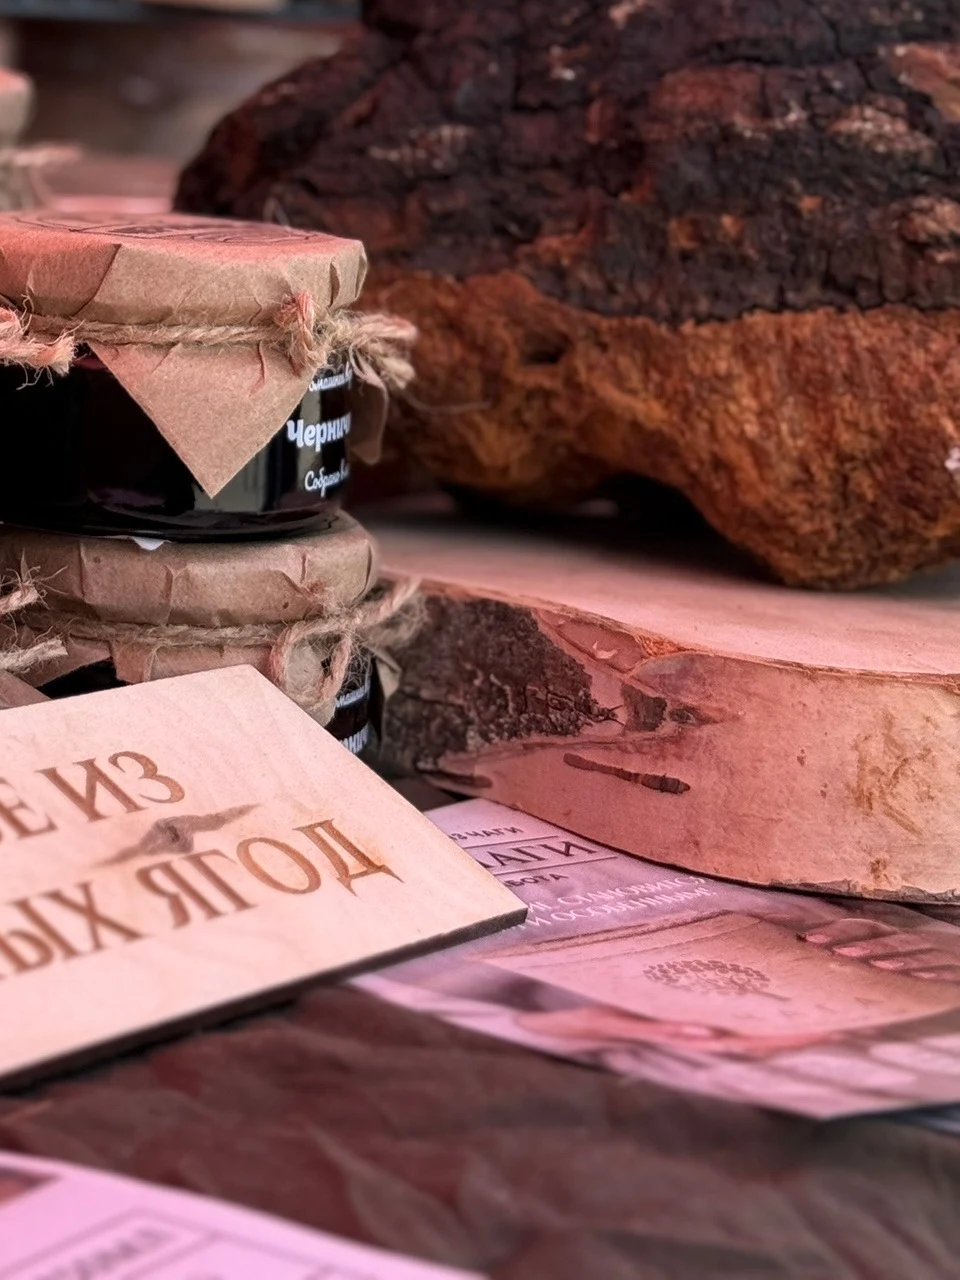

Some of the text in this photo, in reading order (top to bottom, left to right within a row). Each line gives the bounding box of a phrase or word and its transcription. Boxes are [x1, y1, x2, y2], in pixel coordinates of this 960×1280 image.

[36, 750, 187, 824] ИЗ
[136, 817, 405, 931] ЯГОД
[476, 840, 598, 869] АГИ
[503, 873, 570, 888] БОТА
